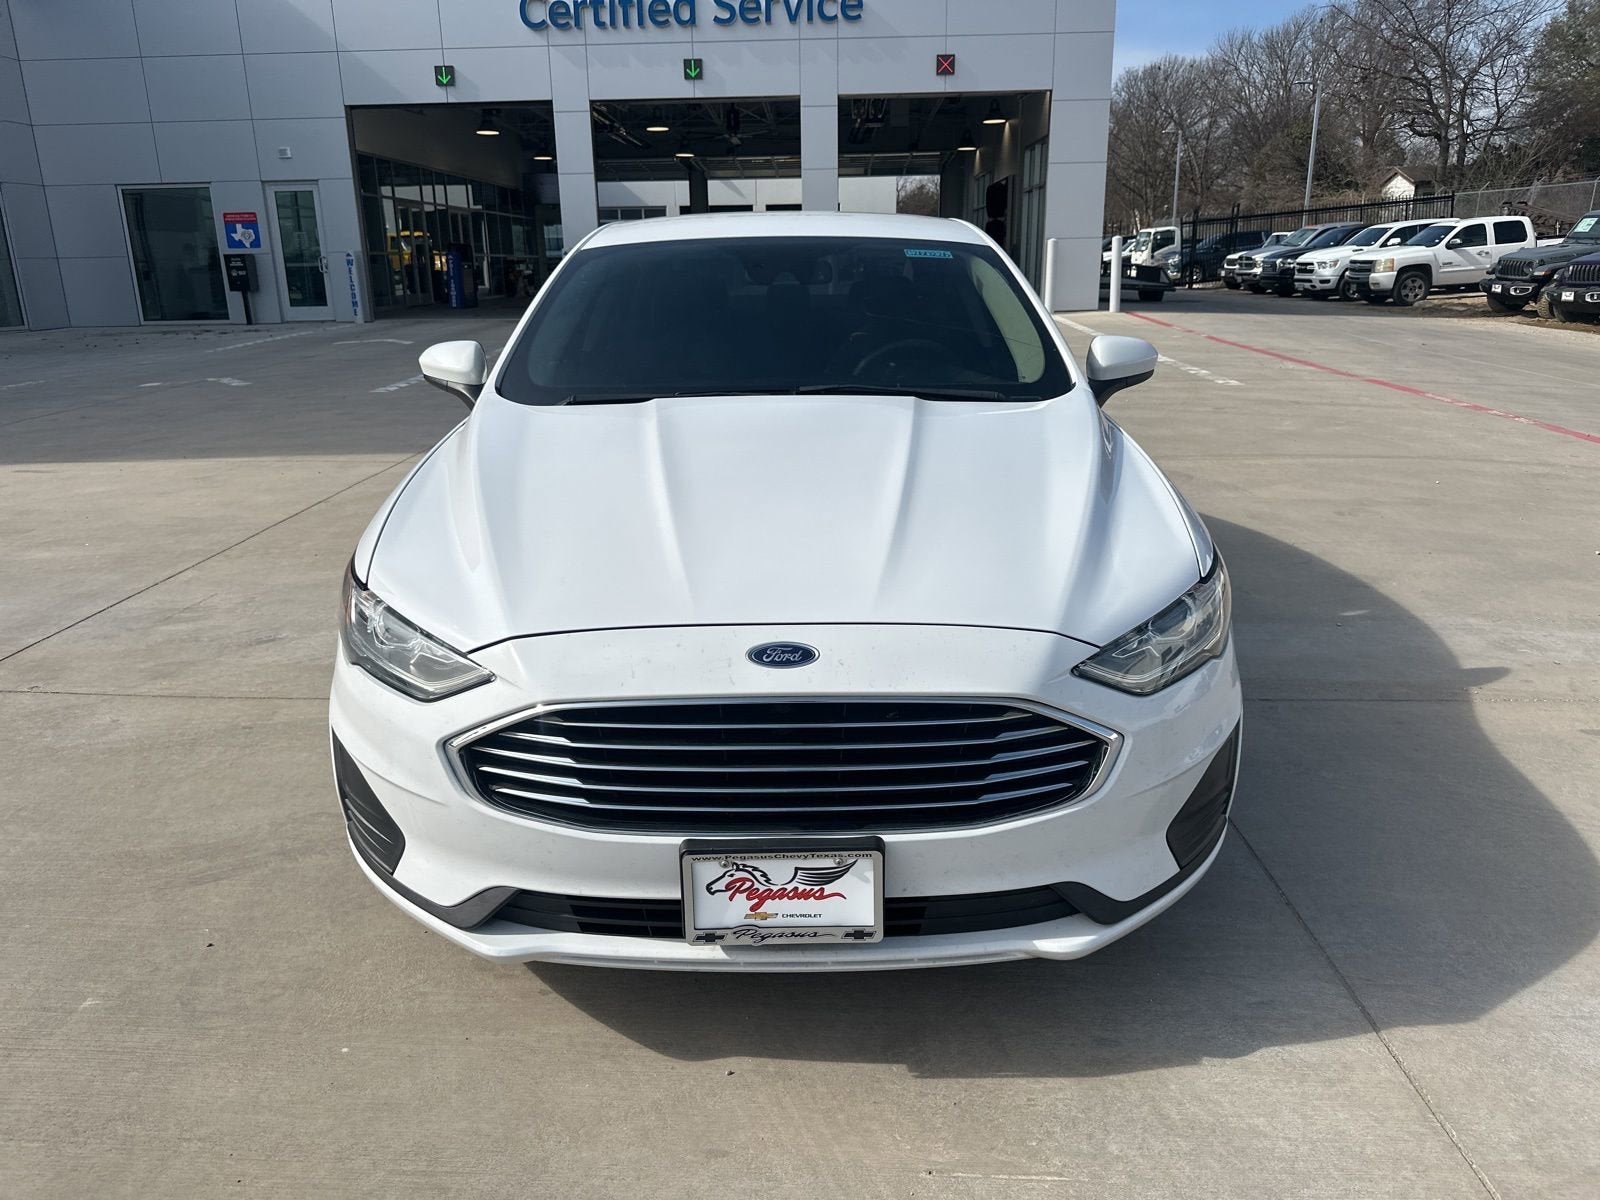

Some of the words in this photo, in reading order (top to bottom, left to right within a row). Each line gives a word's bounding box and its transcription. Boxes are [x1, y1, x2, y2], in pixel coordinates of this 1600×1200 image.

[519, 0, 697, 30] Certified
[713, 0, 864, 26] Service
[345, 258, 359, 317] WELCOME
[762, 647, 803, 663] Ford
[691, 852, 873, 862] www.PegasusChevyTexas.com
[725, 876, 847, 912] Pegasus
[732, 926, 837, 944] Pegasus
